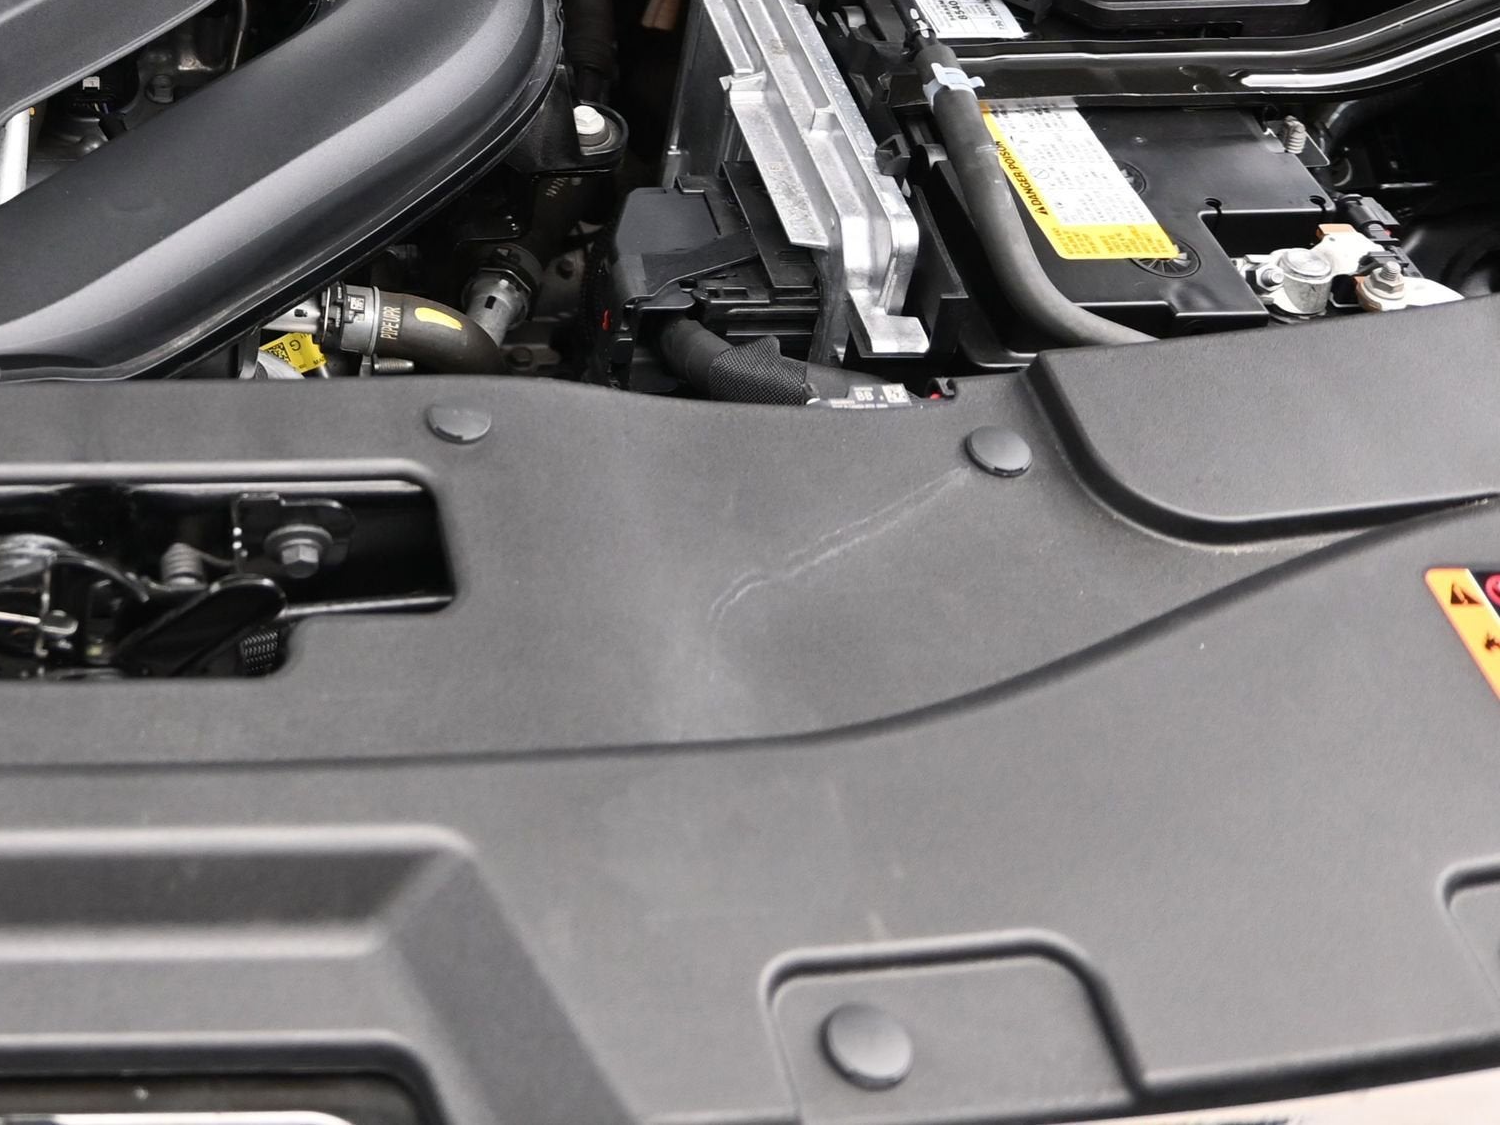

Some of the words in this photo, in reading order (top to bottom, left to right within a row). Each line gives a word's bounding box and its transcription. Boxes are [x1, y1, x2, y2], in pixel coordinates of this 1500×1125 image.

[383, 306, 402, 323] UPR
[380, 321, 400, 340] PIPE
[289, 338, 301, 351] G
